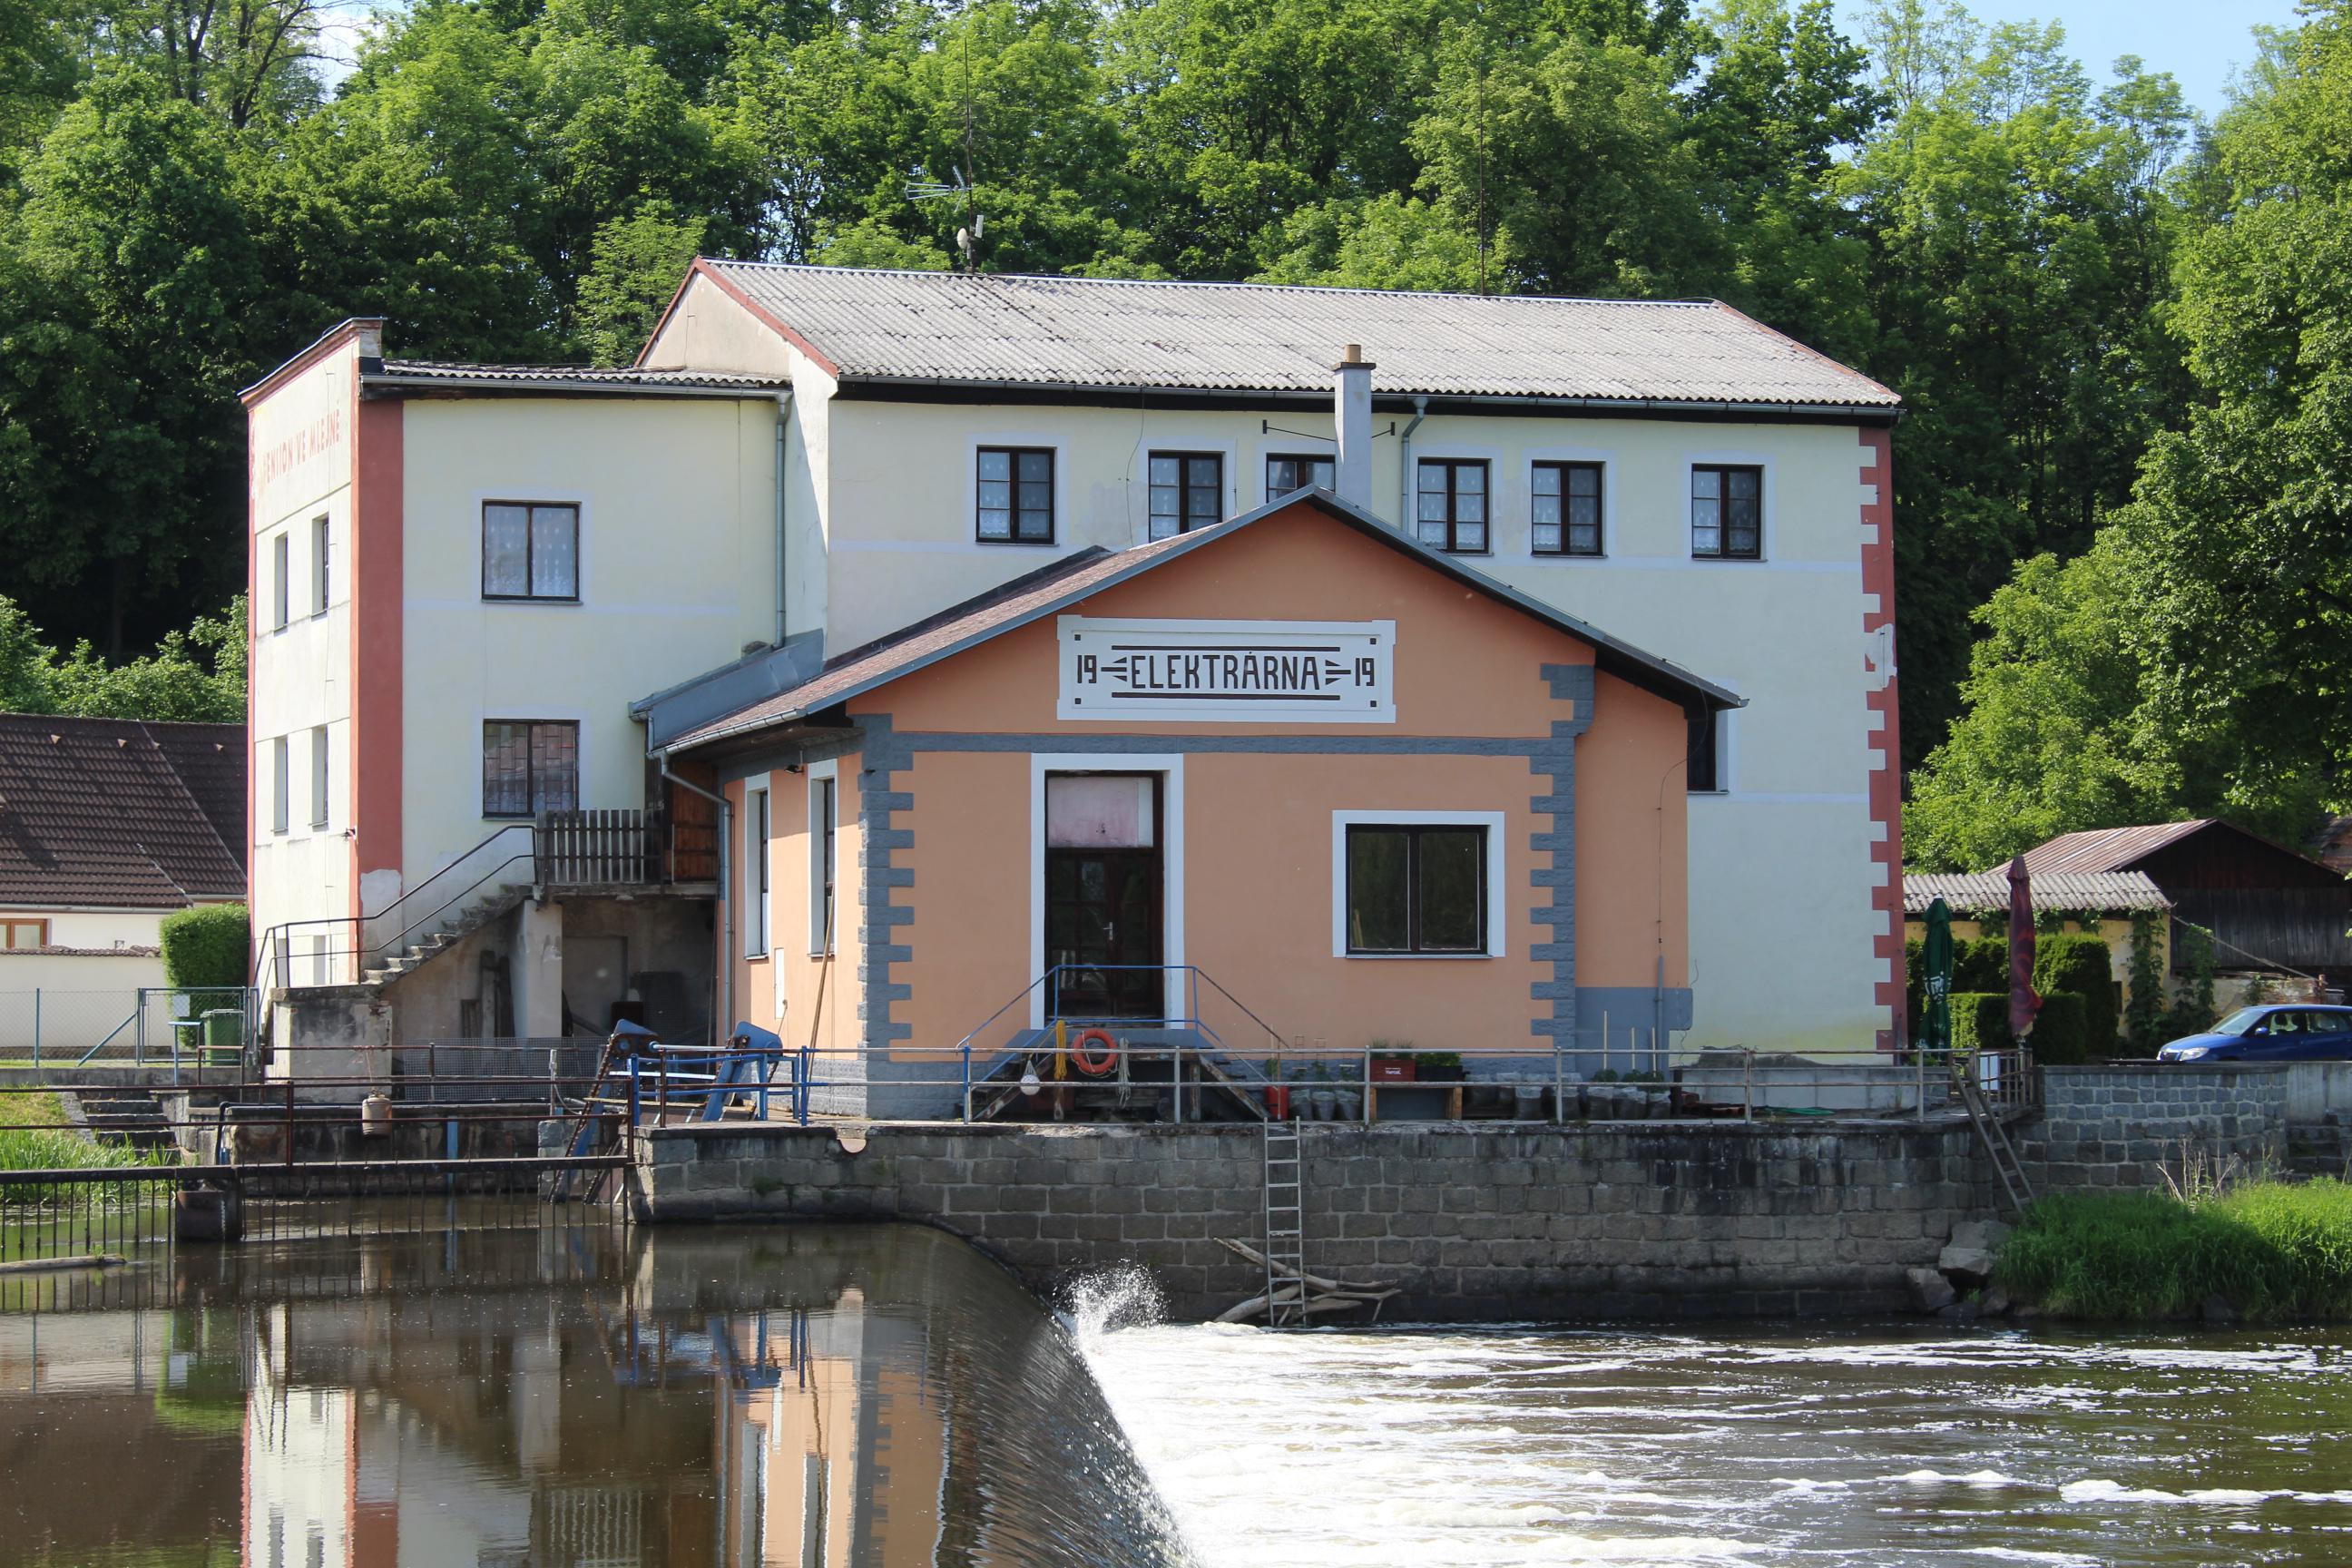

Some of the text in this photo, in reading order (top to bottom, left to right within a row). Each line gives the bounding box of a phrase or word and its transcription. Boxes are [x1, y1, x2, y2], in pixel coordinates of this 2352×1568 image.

[1077, 652, 1375, 691] 19 ELEKTRÁRNA 19
